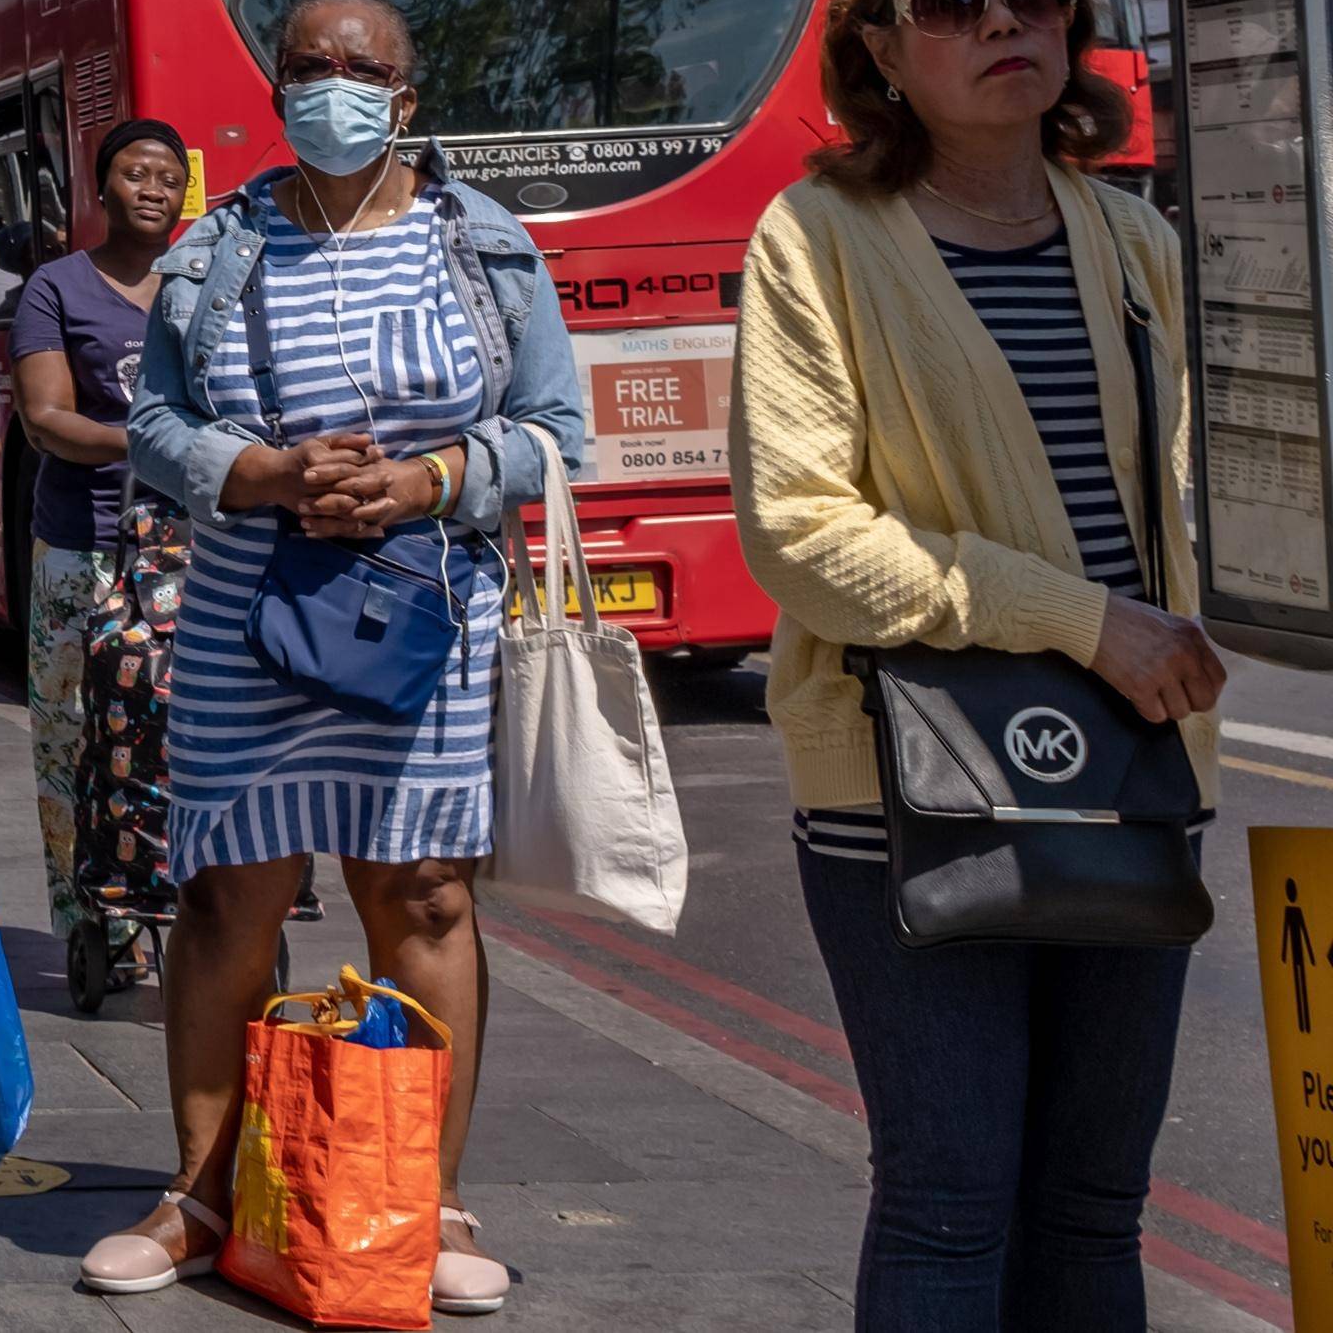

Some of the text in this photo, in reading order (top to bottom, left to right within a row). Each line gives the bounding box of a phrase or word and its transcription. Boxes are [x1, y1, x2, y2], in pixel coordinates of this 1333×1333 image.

[460, 146, 561, 165] VACANCIES
[593, 143, 634, 159] 0800
[638, 141, 659, 156] 38
[661, 139, 683, 156] 99
[687, 138, 696, 154] 7
[701, 138, 723, 154] 99
[635, 273, 714, 295] 400
[622, 336, 732, 353] MATHS ENGLISH
[615, 377, 682, 403] FREE
[617, 406, 683, 428] TRIAL
[620, 438, 642, 448] Book
[622, 452, 667, 468] 0800
[672, 450, 706, 465] 854
[1014, 729, 1077, 761] MK
